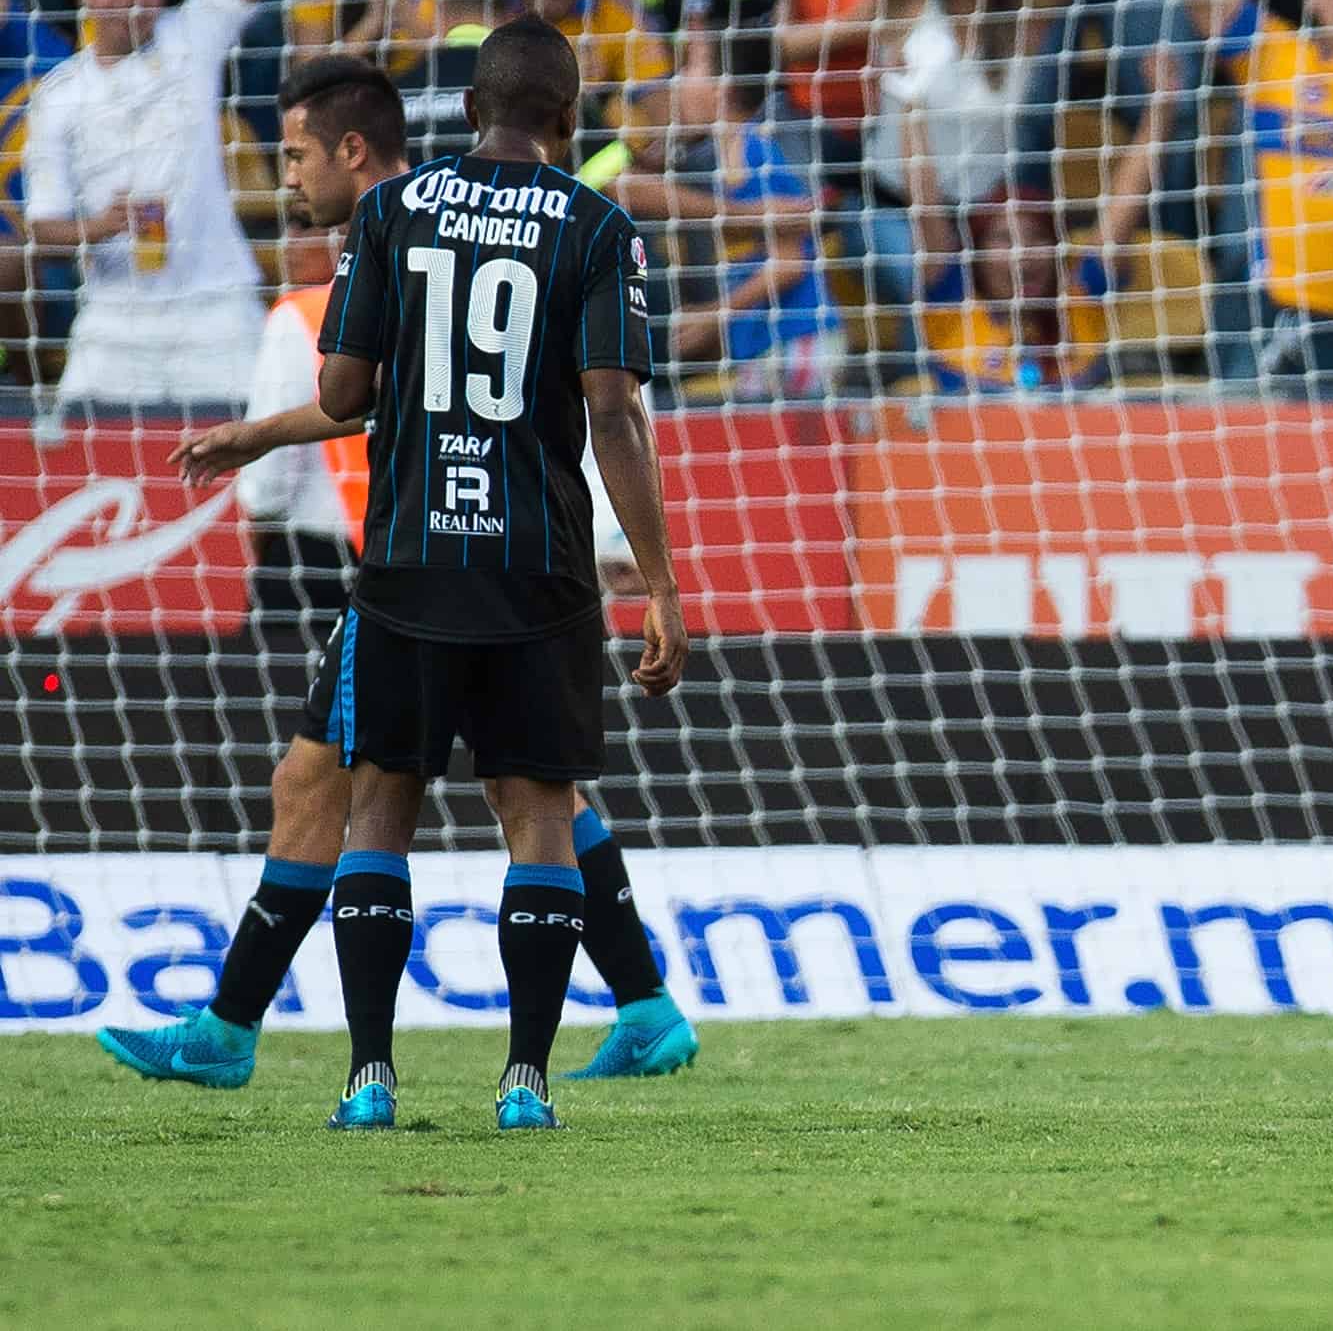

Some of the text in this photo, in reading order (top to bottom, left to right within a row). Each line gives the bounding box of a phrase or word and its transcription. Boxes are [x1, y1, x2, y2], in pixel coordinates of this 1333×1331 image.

[401, 167, 569, 220] Corona
[438, 209, 541, 249] CANDELO
[407, 246, 538, 422] 19
[438, 433, 481, 456] TAR
